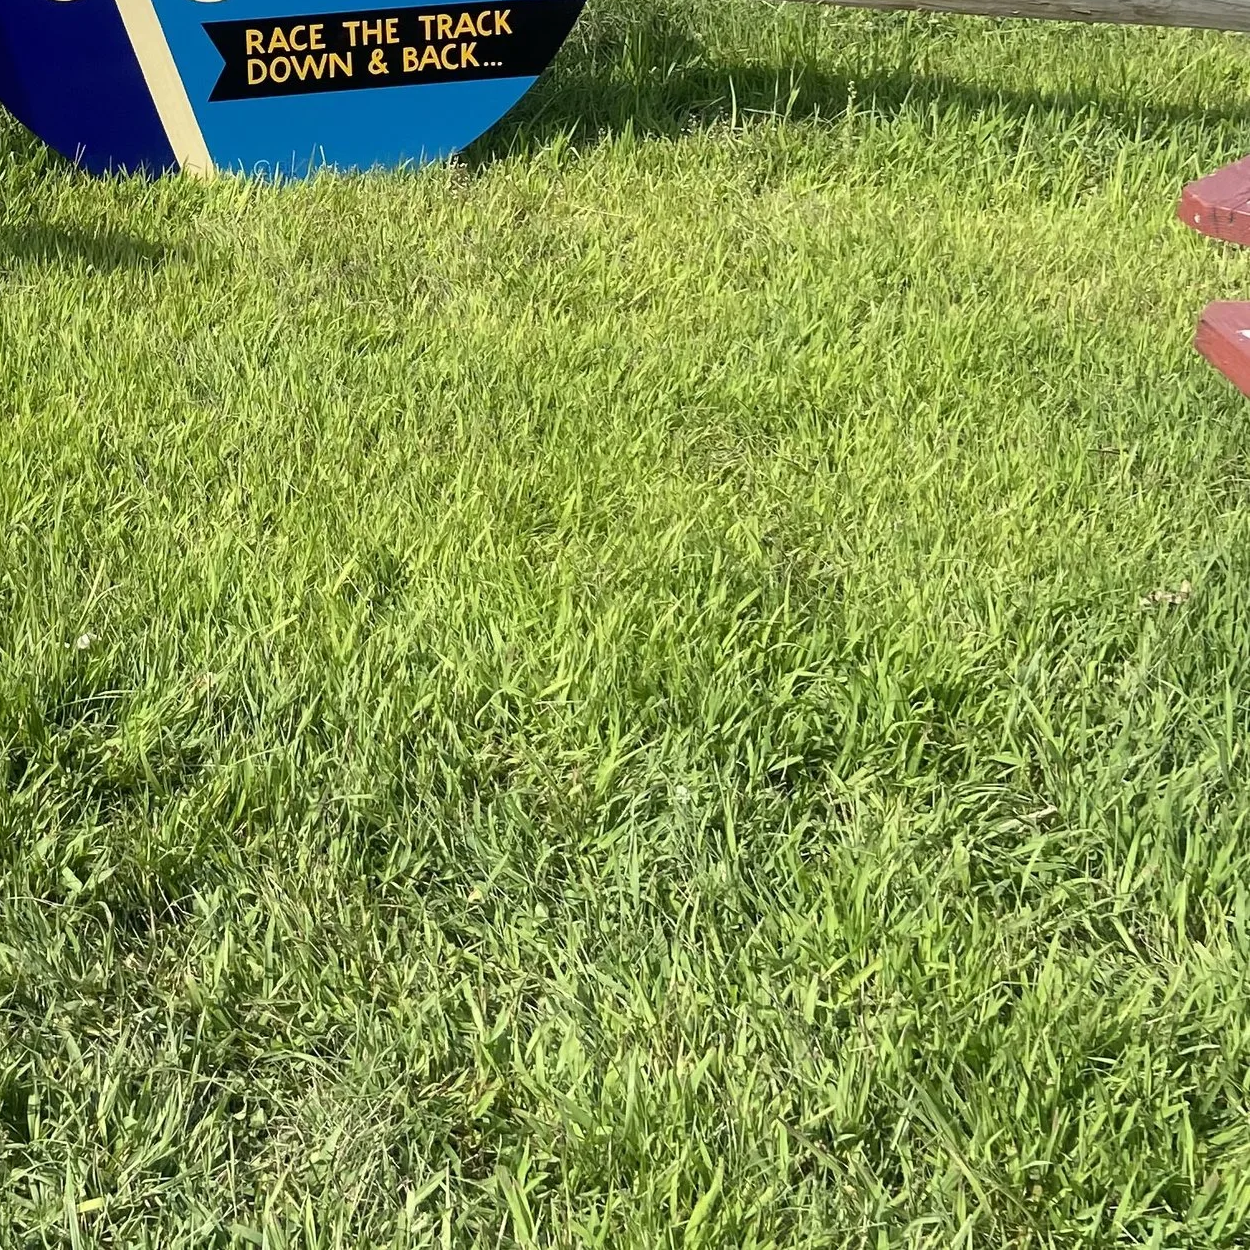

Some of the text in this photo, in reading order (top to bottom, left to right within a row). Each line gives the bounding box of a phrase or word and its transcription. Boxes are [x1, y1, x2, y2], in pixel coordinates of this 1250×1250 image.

[245, 9, 513, 55] RACE THE TRACK
[247, 42, 503, 85] DOWN & BACK...
